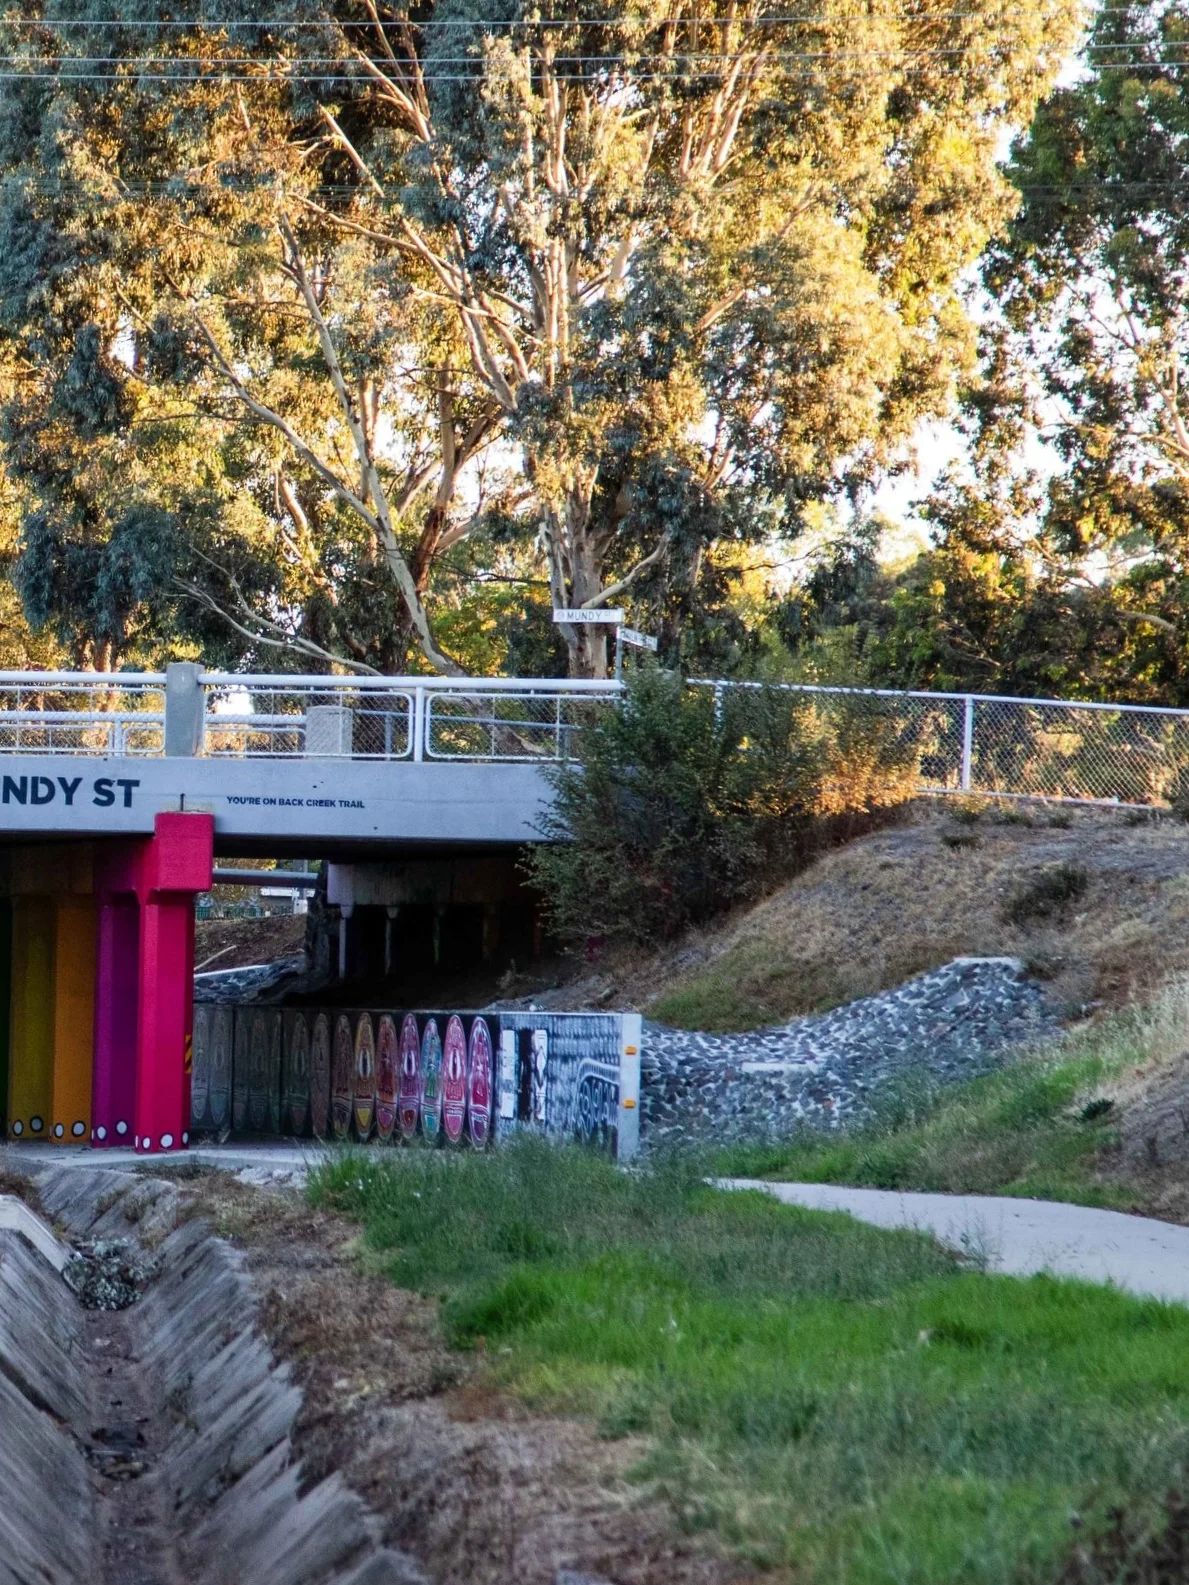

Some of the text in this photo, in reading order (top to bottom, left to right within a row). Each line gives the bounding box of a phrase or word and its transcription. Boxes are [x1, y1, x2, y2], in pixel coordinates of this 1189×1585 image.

[567, 611, 601, 620] MUNDY
[92, 778, 141, 808] ST
[227, 796, 365, 809] YOU'RE ON BACK CREEK TRAIL
